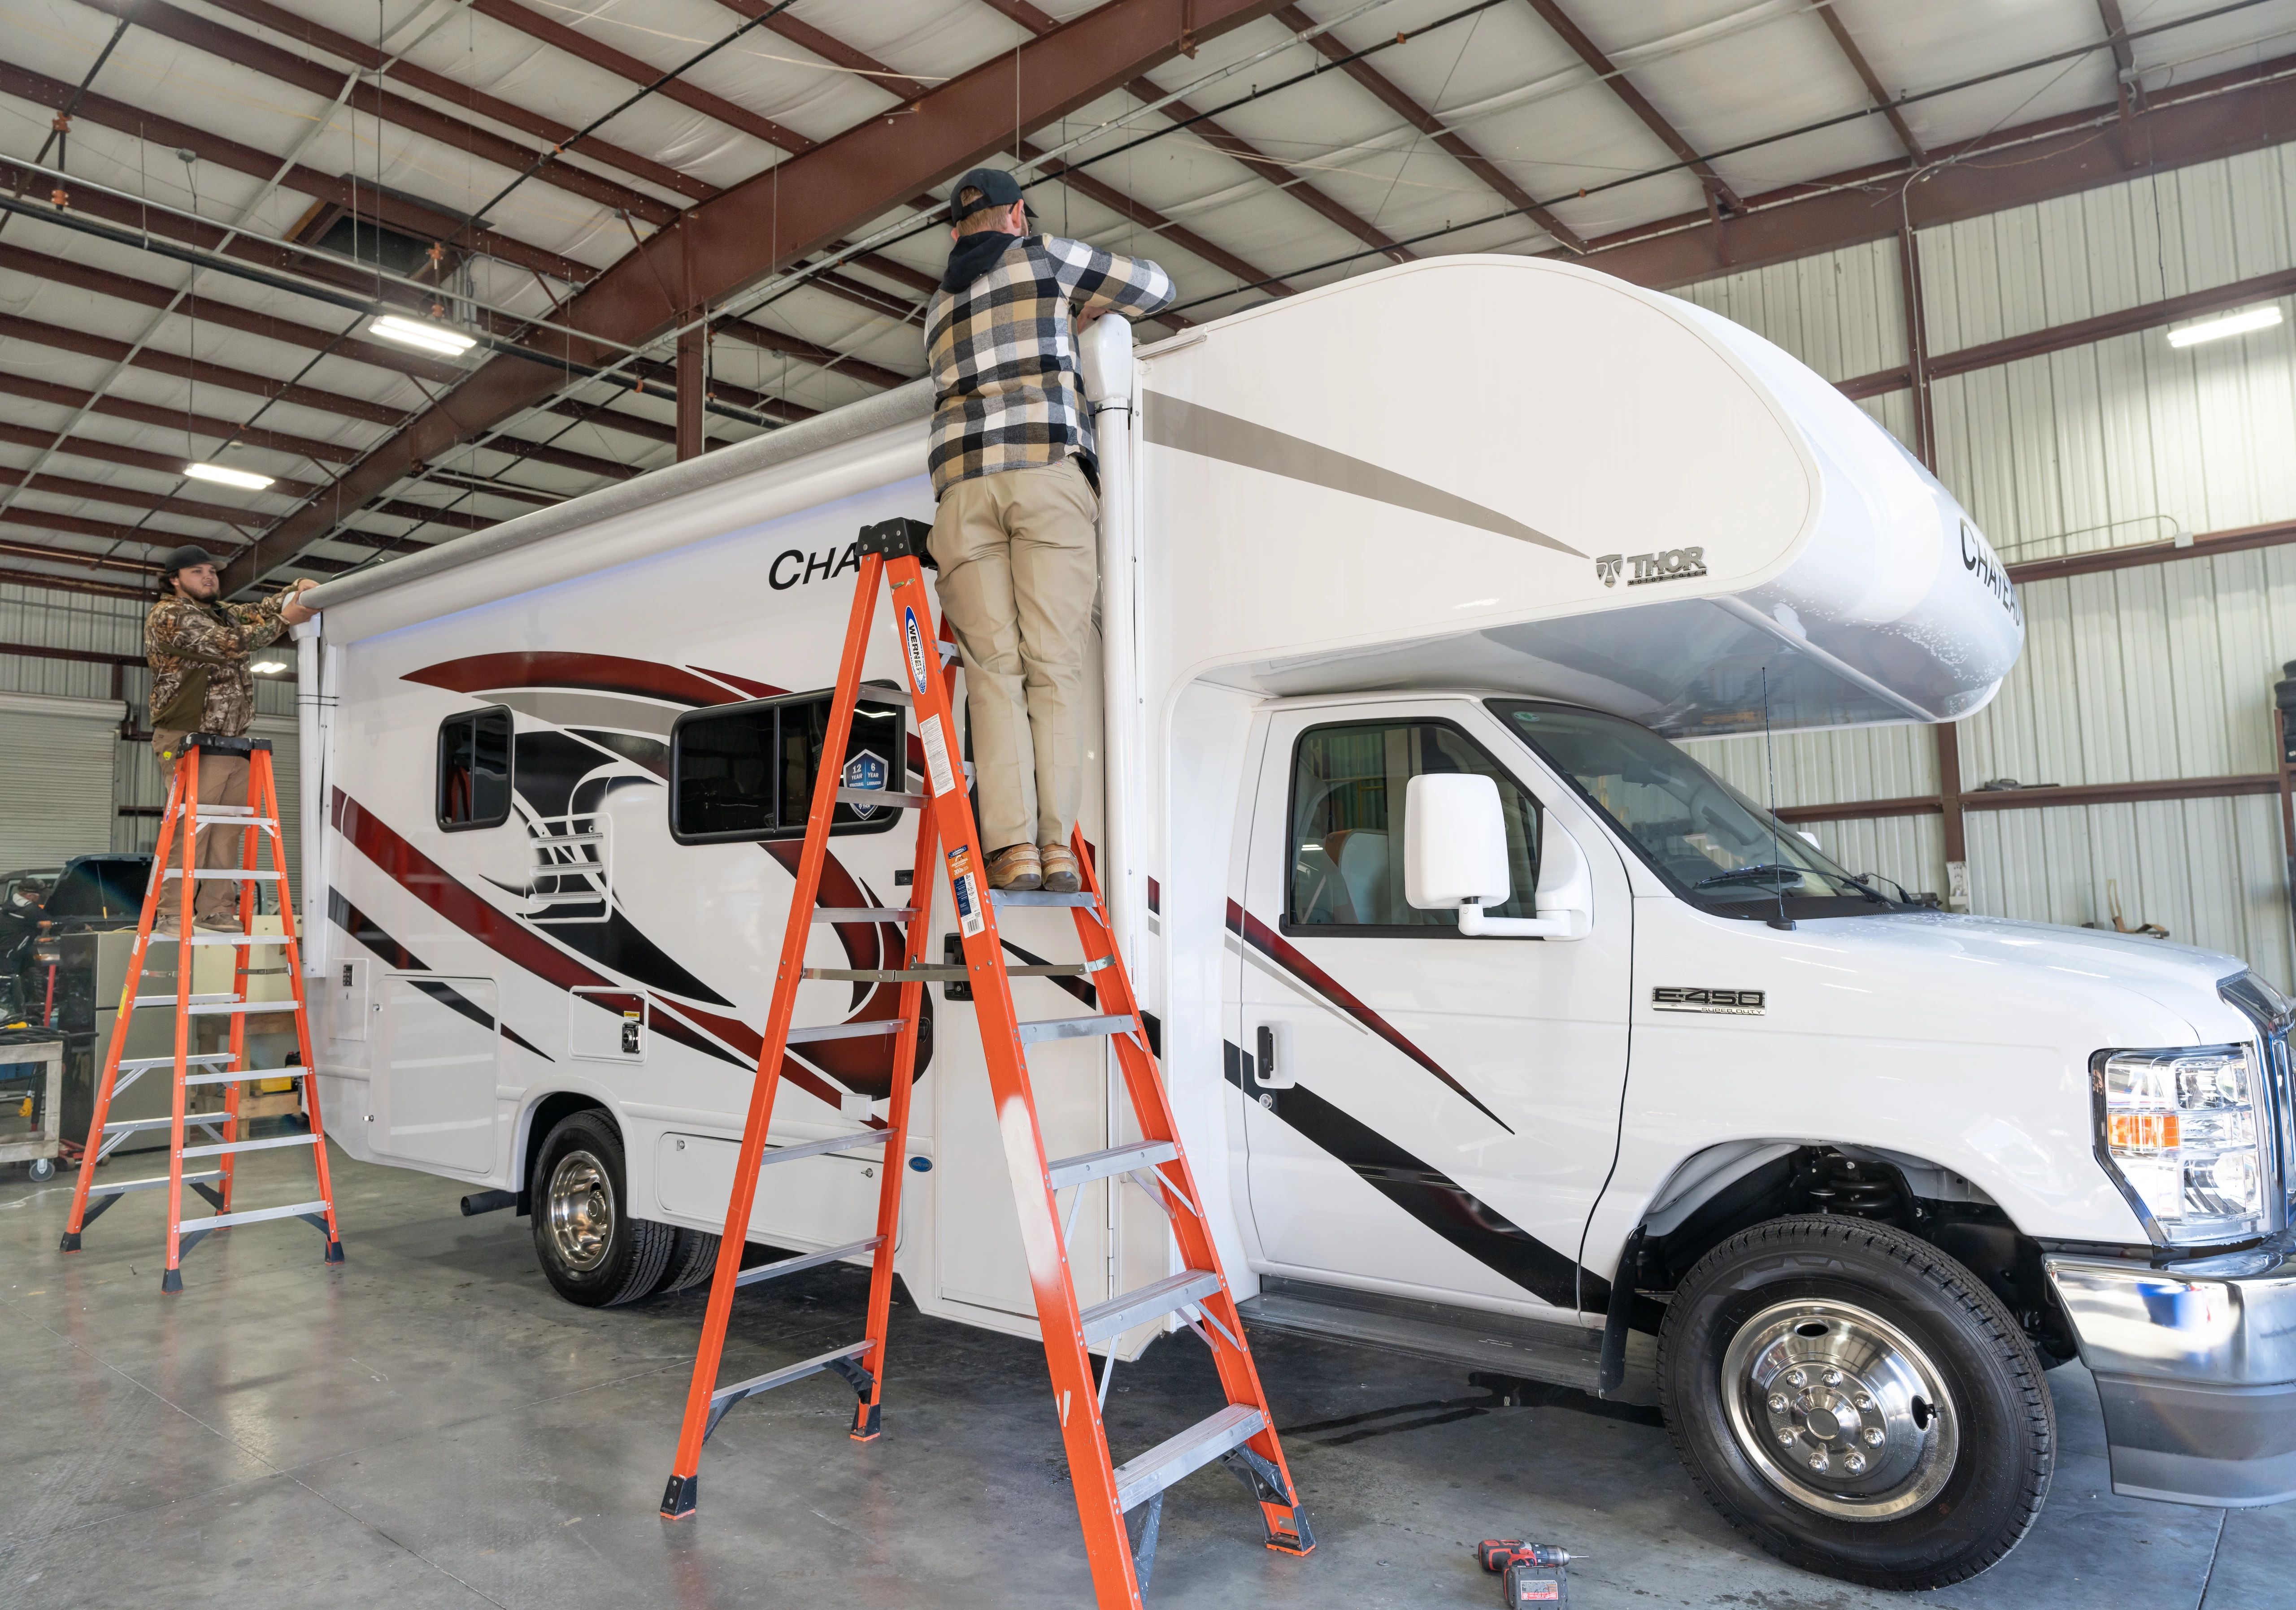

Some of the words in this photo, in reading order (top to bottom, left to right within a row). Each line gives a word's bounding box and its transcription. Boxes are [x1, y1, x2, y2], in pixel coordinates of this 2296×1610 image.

[769, 542, 861, 590] CHA
[1627, 546, 1708, 578] THOR
[1629, 576, 1663, 586] MOTOR
[1672, 570, 1707, 579] COACH
[1960, 517, 2020, 627] CHATEAU
[909, 624, 923, 676] WERNER
[852, 764, 861, 774] 12
[870, 763, 876, 772] 6
